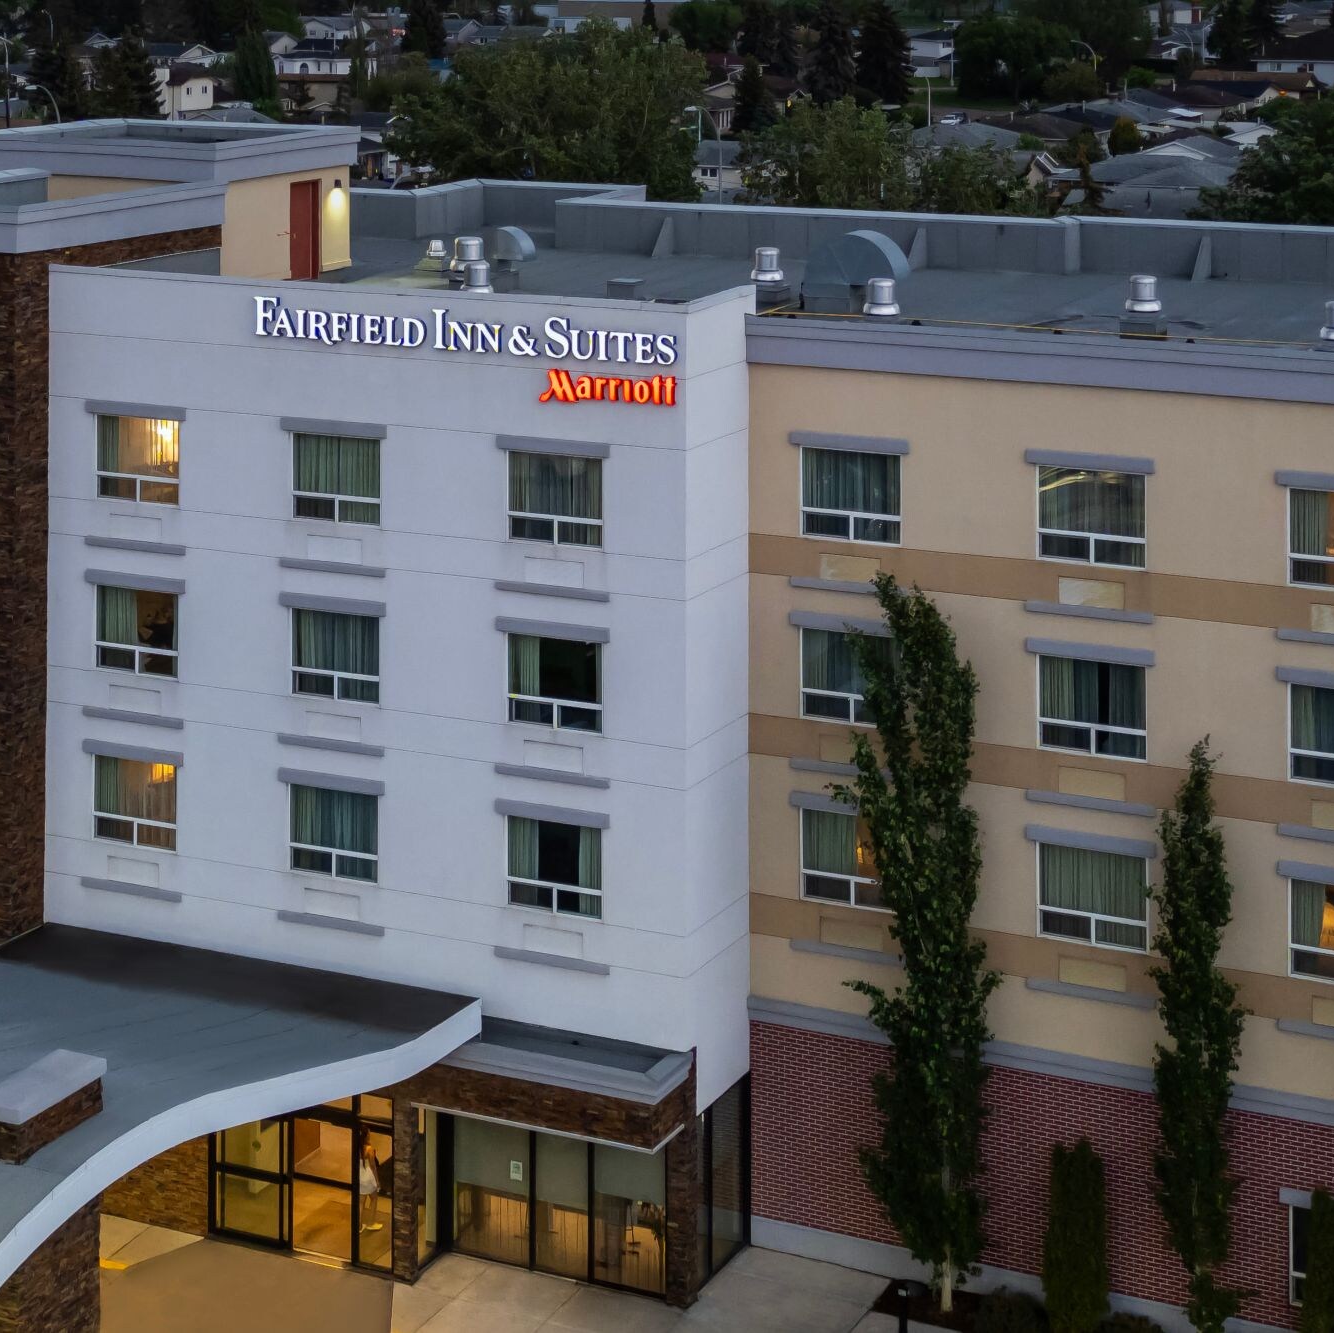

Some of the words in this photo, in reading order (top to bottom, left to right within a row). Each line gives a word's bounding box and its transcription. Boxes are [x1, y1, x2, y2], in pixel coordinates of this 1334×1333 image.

[254, 296, 427, 347] FAIRFIELD
[432, 308, 503, 354] INN
[508, 325, 541, 357] &
[544, 316, 678, 366] SUITES
[538, 368, 677, 407] Marriott
